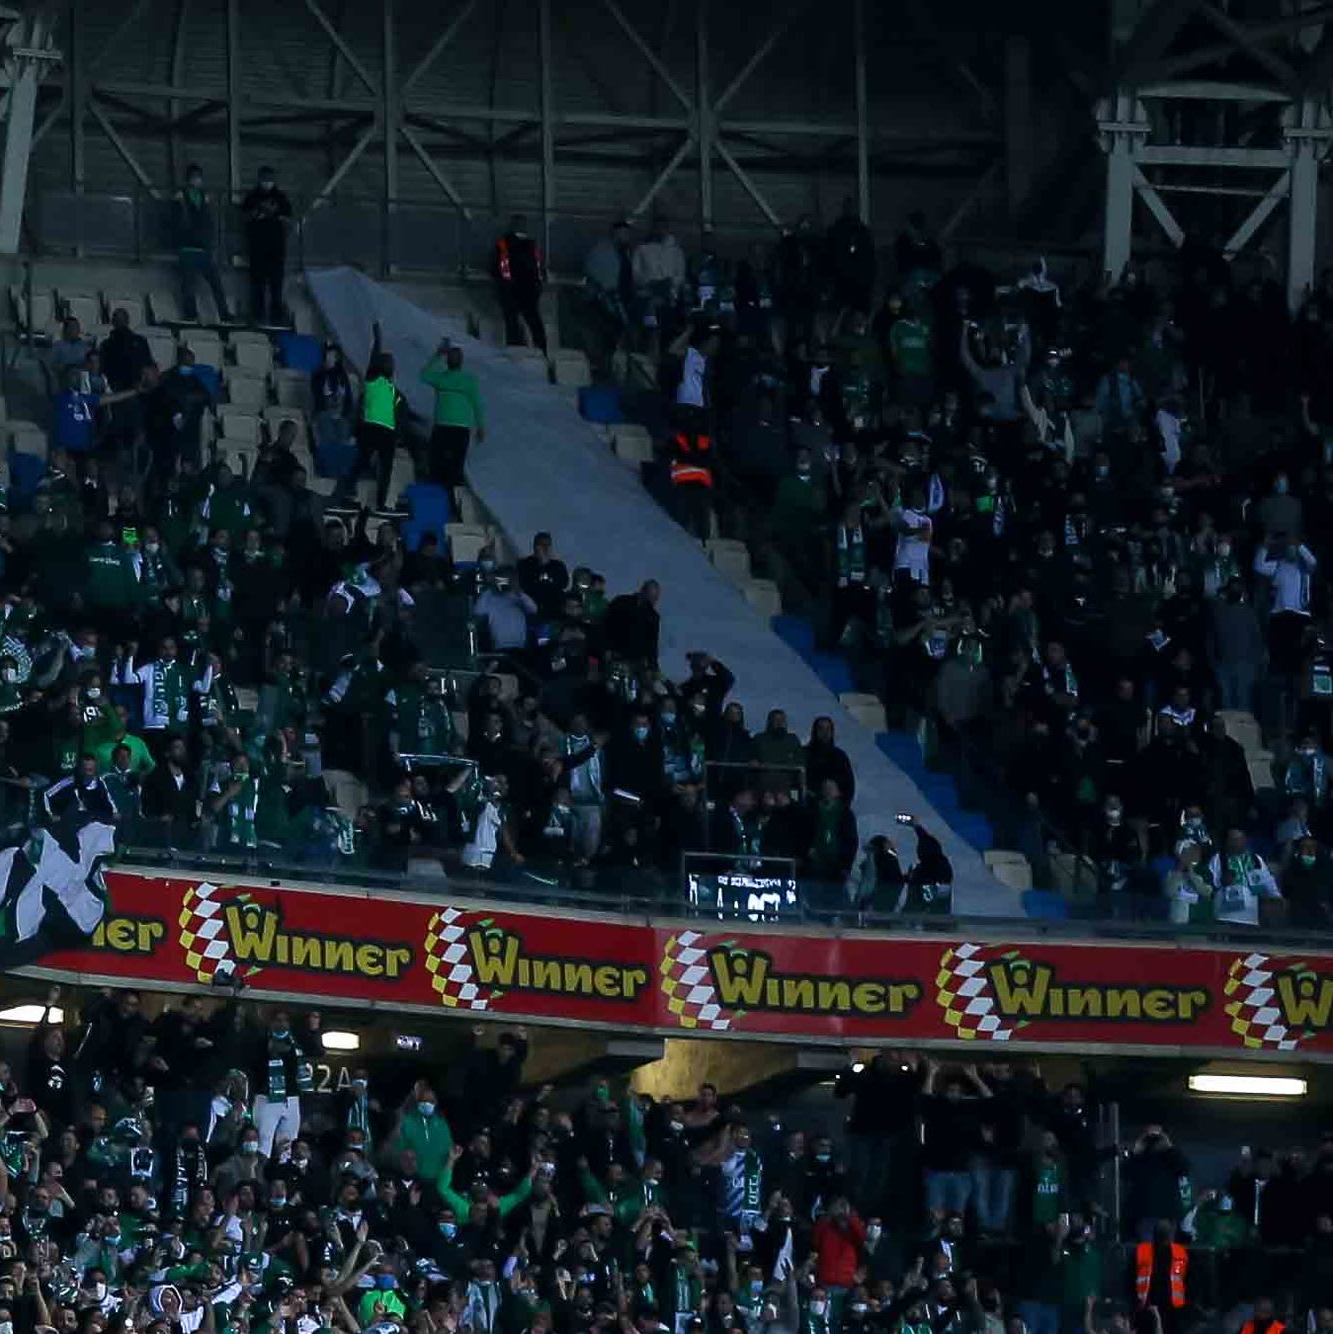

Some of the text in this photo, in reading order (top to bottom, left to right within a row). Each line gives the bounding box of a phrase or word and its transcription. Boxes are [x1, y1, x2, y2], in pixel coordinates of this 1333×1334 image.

[226, 905, 411, 978] Winner
[474, 930, 645, 997] Winner
[712, 950, 919, 1014] Winner
[989, 961, 1208, 1020] Winner
